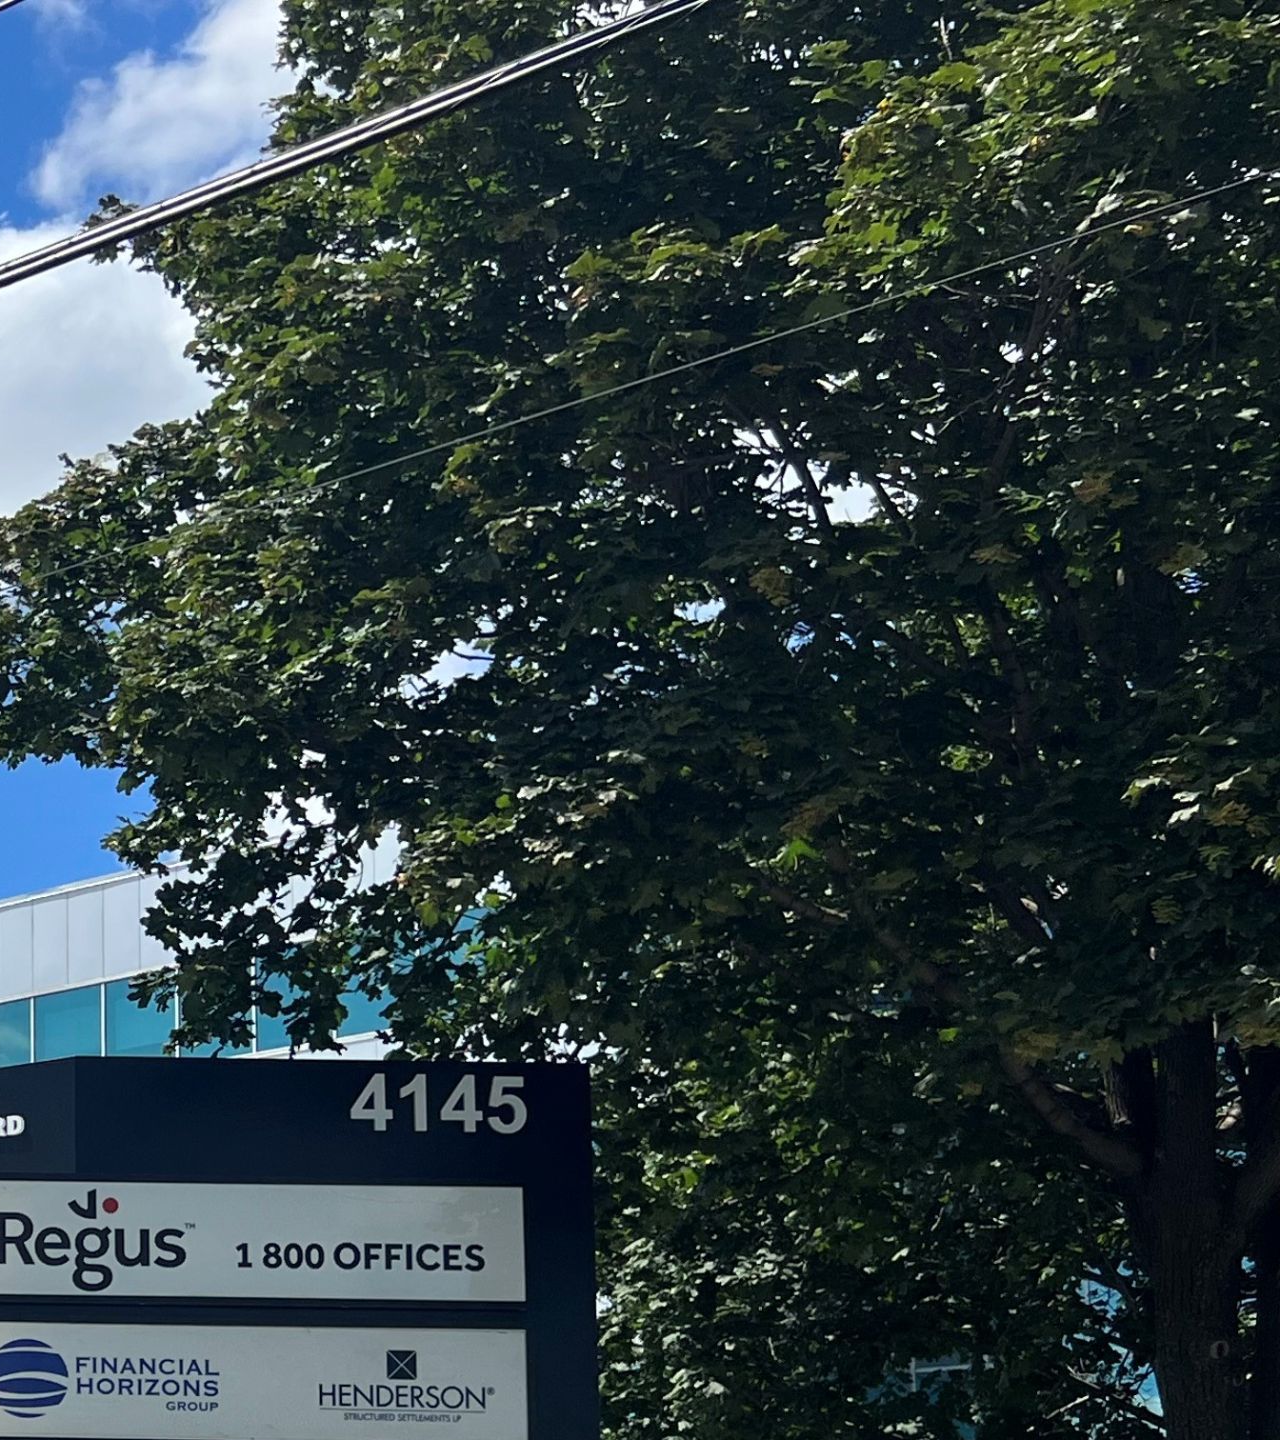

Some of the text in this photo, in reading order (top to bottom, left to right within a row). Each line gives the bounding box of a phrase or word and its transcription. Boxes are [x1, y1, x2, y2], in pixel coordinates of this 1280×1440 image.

[349, 1072, 528, 1135] 4145
[235, 1242, 486, 1272] 1 800 OFFICES
[75, 1356, 220, 1376] FINANCIAL
[76, 1377, 219, 1397] HORIZONS
[165, 1401, 219, 1412] GROUP
[343, 1412, 396, 1422] STRUCTURED
[397, 1413, 451, 1423] SETTLEMENTS
